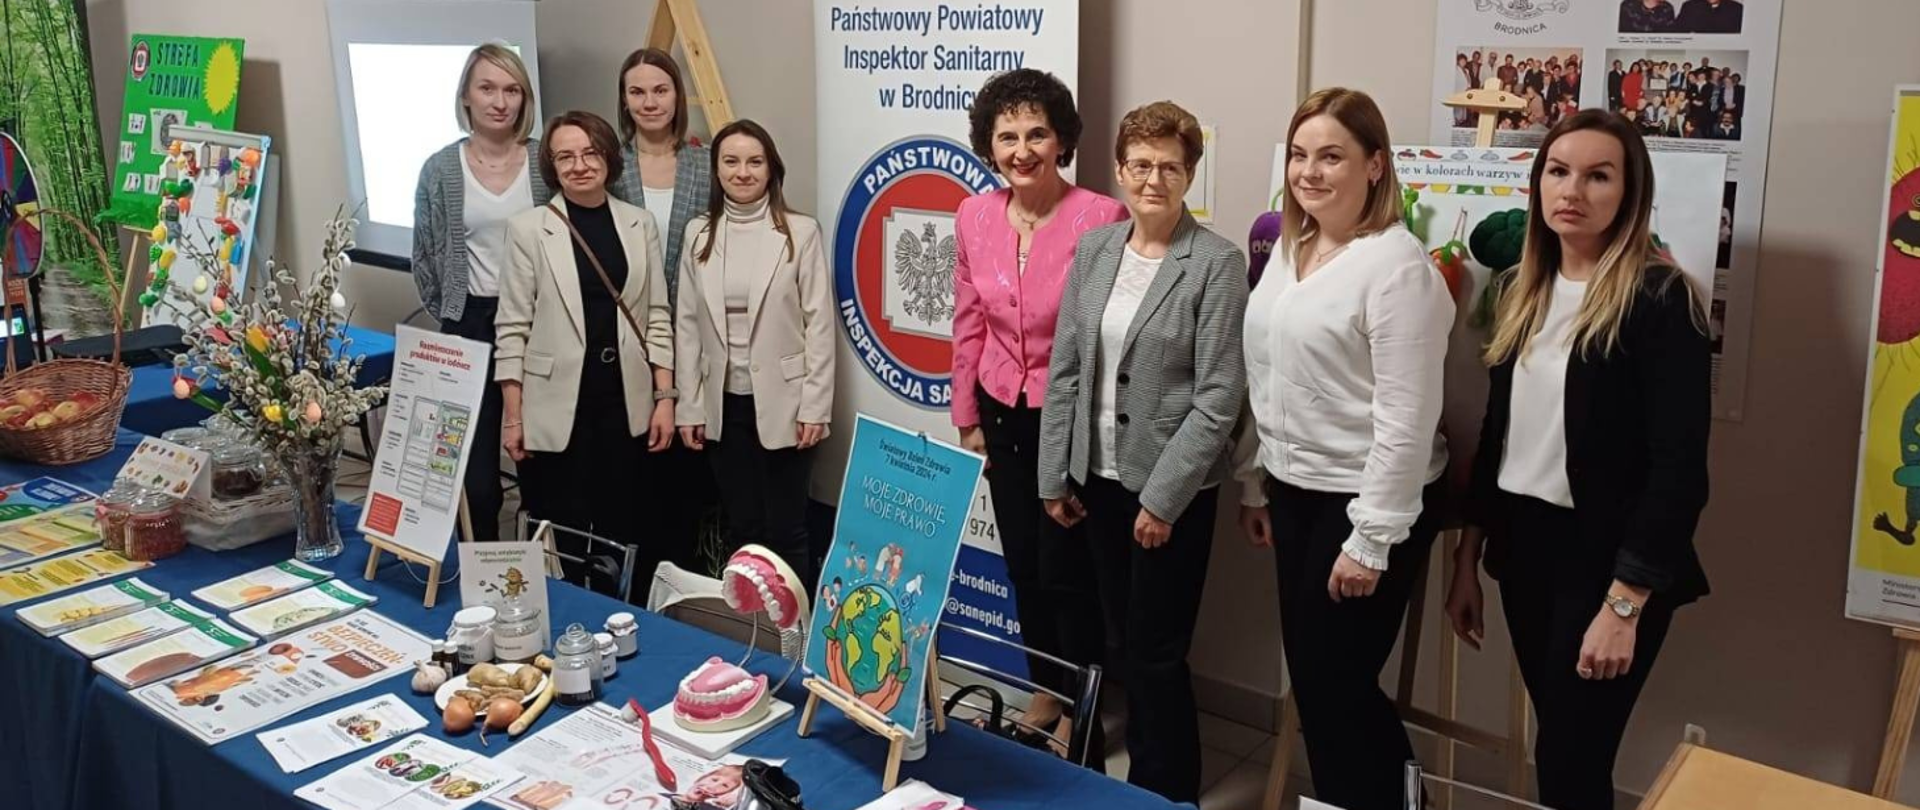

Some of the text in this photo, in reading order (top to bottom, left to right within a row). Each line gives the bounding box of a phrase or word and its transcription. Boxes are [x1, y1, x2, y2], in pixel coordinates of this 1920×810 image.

[831, 4, 1044, 36] Państwowy Powiatowy
[1494, 21, 1547, 35] BRODNICA
[157, 43, 199, 67] STREFA
[844, 44, 1025, 74] Inspektor Sanitarny
[148, 73, 200, 99] ZDROWIA
[879, 88, 896, 108] w
[1413, 166, 1423, 175] w
[1426, 165, 1474, 177] kolorach
[1476, 169, 1522, 182] warzyw
[840, 299, 924, 404] INSPEKCJA
[862, 475, 892, 499] MOJE
[864, 493, 936, 537] MOJE PRAWO
[969, 518, 996, 541] 974
